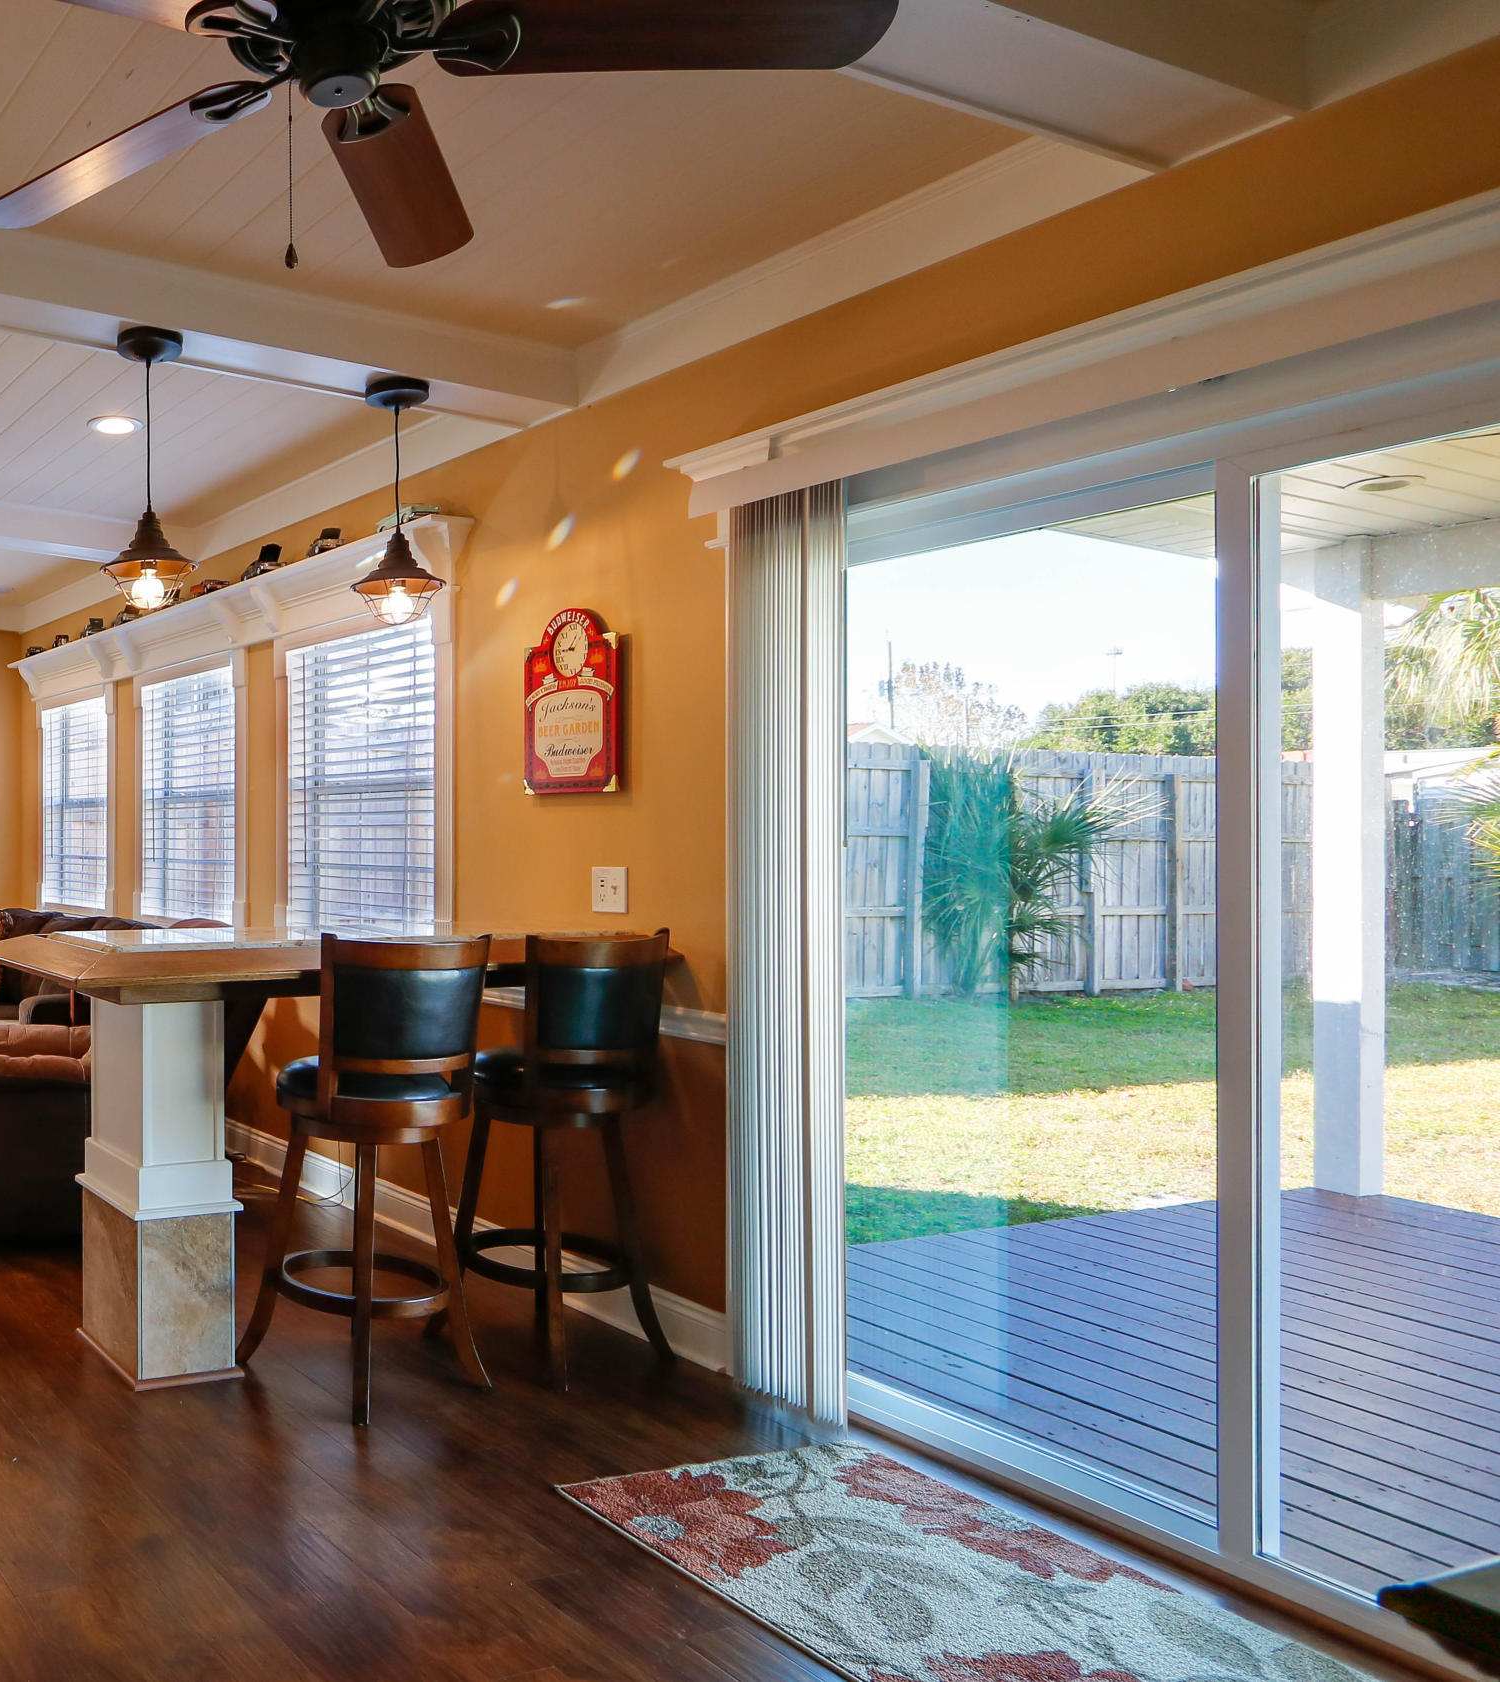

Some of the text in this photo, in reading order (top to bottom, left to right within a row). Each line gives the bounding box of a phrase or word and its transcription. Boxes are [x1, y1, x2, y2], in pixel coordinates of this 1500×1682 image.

[546, 611, 590, 636] BUDWEISER
[559, 679, 577, 688] ENJOY
[539, 697, 596, 723] Jackson's
[538, 721, 600, 739] BEER GARDEN
[544, 744, 594, 758] Budweiser
